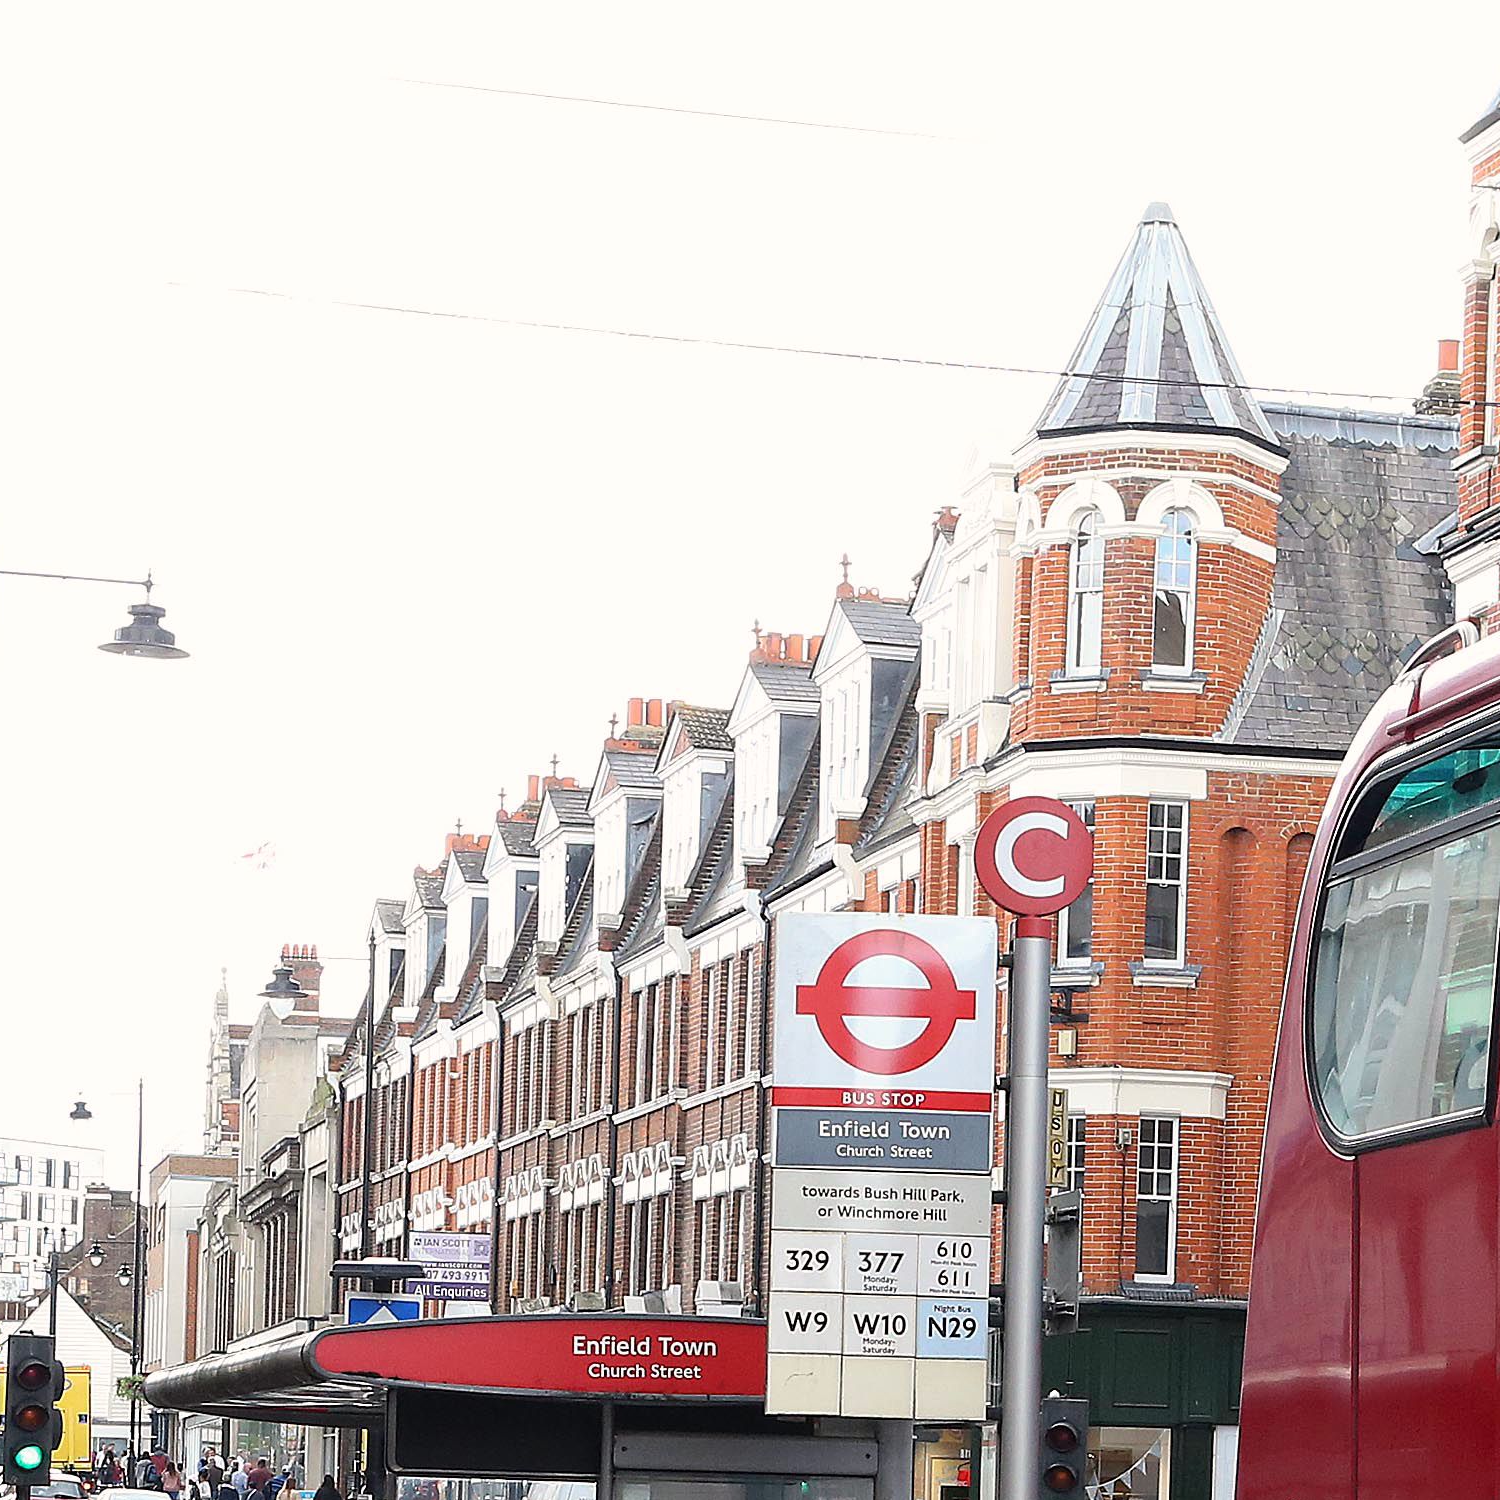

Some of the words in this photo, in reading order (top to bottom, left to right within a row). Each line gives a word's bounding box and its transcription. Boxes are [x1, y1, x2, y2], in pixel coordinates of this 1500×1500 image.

[994, 811, 1069, 898] C
[842, 1091, 875, 1105] BUS
[881, 1093, 925, 1106] STOP
[819, 1120, 889, 1138] Enfield
[899, 1122, 950, 1140] Town
[836, 1144, 884, 1157] Church
[890, 1145, 932, 1159] Street
[802, 1186, 859, 1198] towards
[865, 1187, 897, 1200] Bush
[903, 1188, 926, 1201] Hill
[931, 1190, 964, 1204] Park,
[818, 1207, 833, 1216] or
[838, 1206, 918, 1220] Winchmore
[924, 1209, 947, 1221] Hill
[423, 1239, 440, 1247] IAN
[442, 1239, 471, 1248] SCOTT
[786, 1250, 829, 1271] 329
[858, 1252, 904, 1273] 377
[937, 1241, 972, 1259] 610
[442, 1270, 461, 1280] 493
[465, 1271, 490, 1281] 9911
[864, 1276, 898, 1285] Monday-
[938, 1270, 970, 1287] 611
[415, 1285, 429, 1296] All
[434, 1285, 487, 1299] Enquiries
[863, 1284, 898, 1293] Saturday
[934, 1305, 955, 1313] Night
[957, 1305, 971, 1313] Bus
[785, 1311, 828, 1333] W9
[853, 1314, 906, 1335] W10
[928, 1317, 977, 1339] N29
[573, 1335, 650, 1356] Enfield
[658, 1337, 717, 1357] Town
[863, 1338, 895, 1347] Monday-
[862, 1346, 896, 1355] Saturday
[588, 1364, 645, 1378] Church
[650, 1364, 702, 1379] Street
